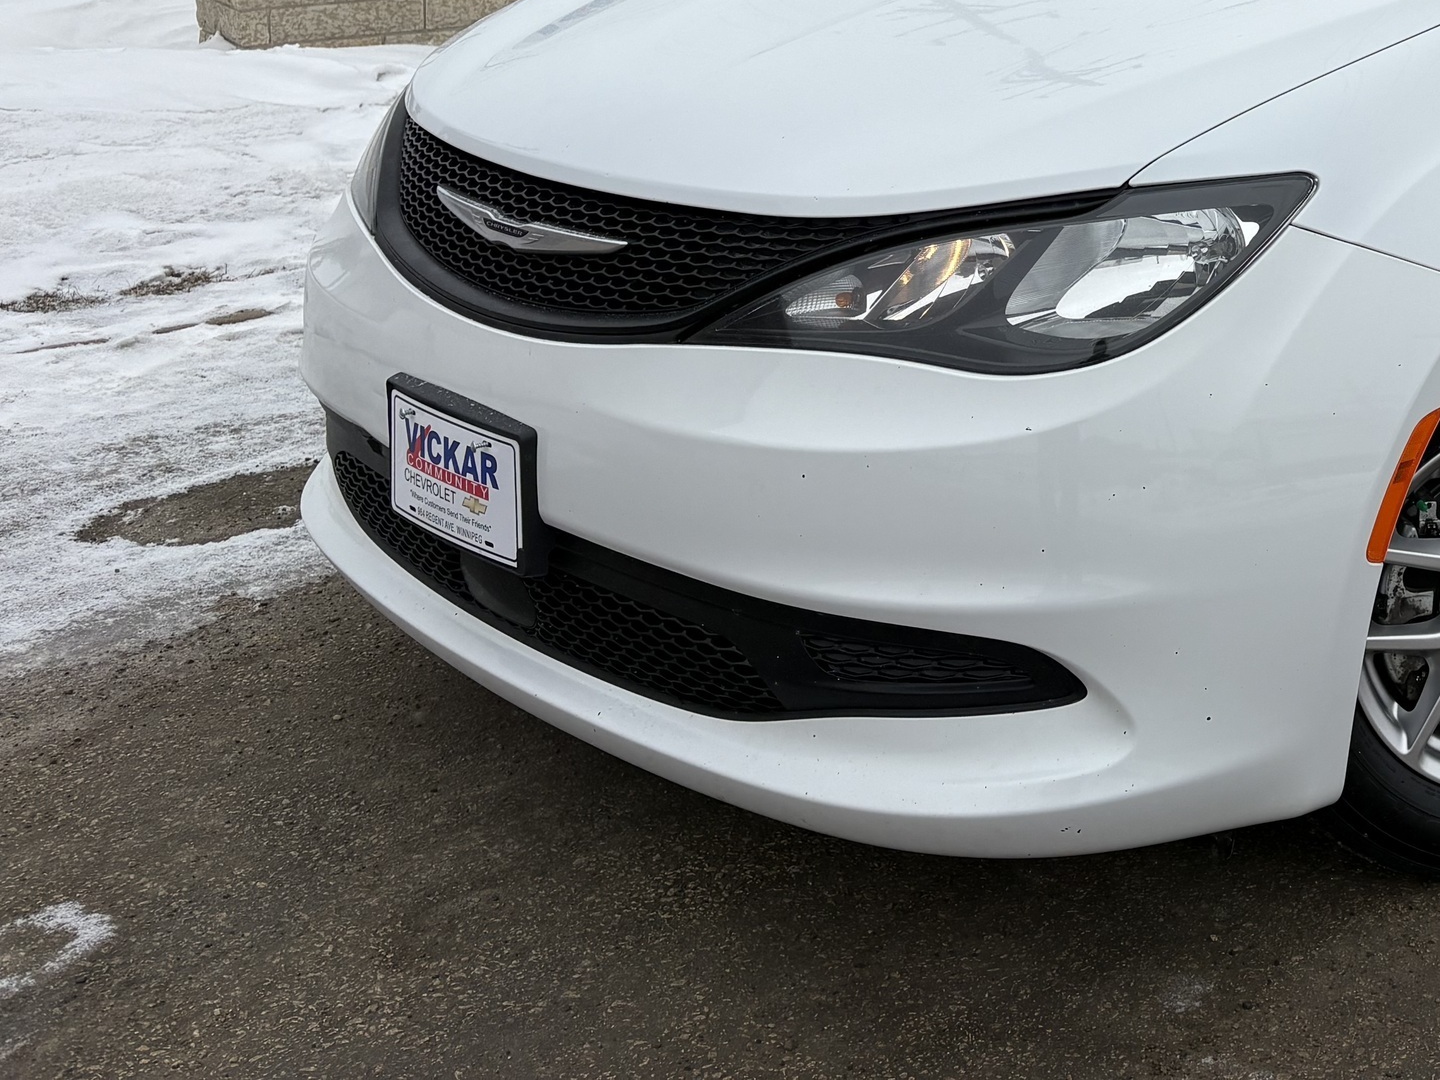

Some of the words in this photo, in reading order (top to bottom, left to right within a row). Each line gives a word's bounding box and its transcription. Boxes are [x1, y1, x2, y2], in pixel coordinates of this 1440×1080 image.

[486, 220, 523, 236] CHRYSLER
[404, 417, 500, 490] VICKAR
[404, 467, 456, 505] CHEVROLET
[407, 453, 489, 499] COMMUNITY
[424, 497, 446, 514] Customers
[447, 508, 459, 520] Send
[459, 513, 471, 525] Their
[425, 510, 445, 527] REGENT
[456, 525, 483, 544] WINNIPEG
